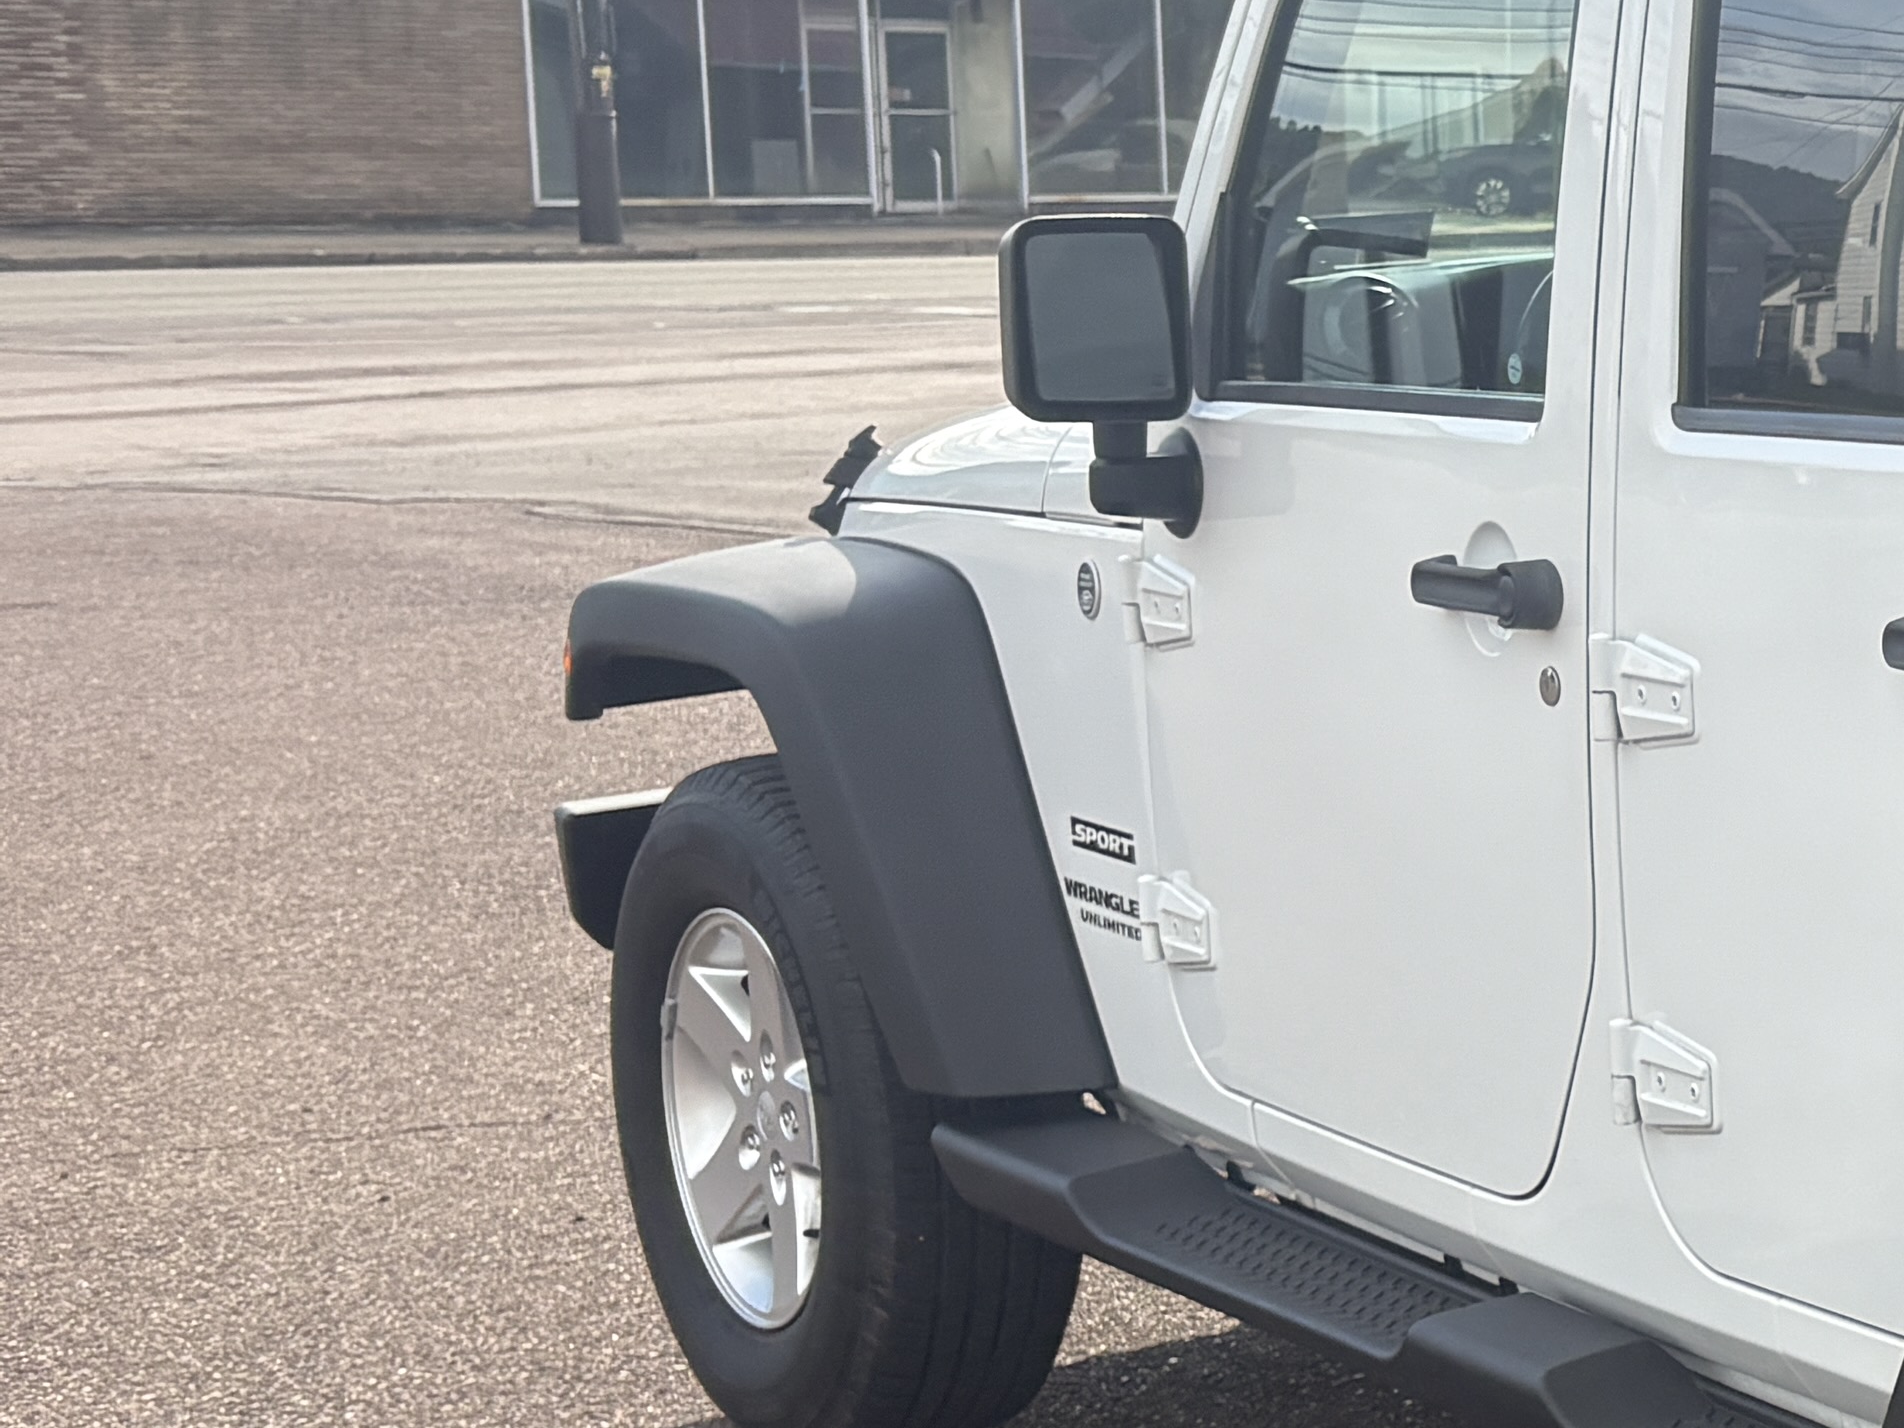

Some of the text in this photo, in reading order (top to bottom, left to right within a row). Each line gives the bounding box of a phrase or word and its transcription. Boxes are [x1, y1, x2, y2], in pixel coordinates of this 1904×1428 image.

[1073, 823, 1136, 856] SPORT
[1063, 876, 1140, 920] WRANGLE
[1080, 907, 1142, 942] UNLIMITED
